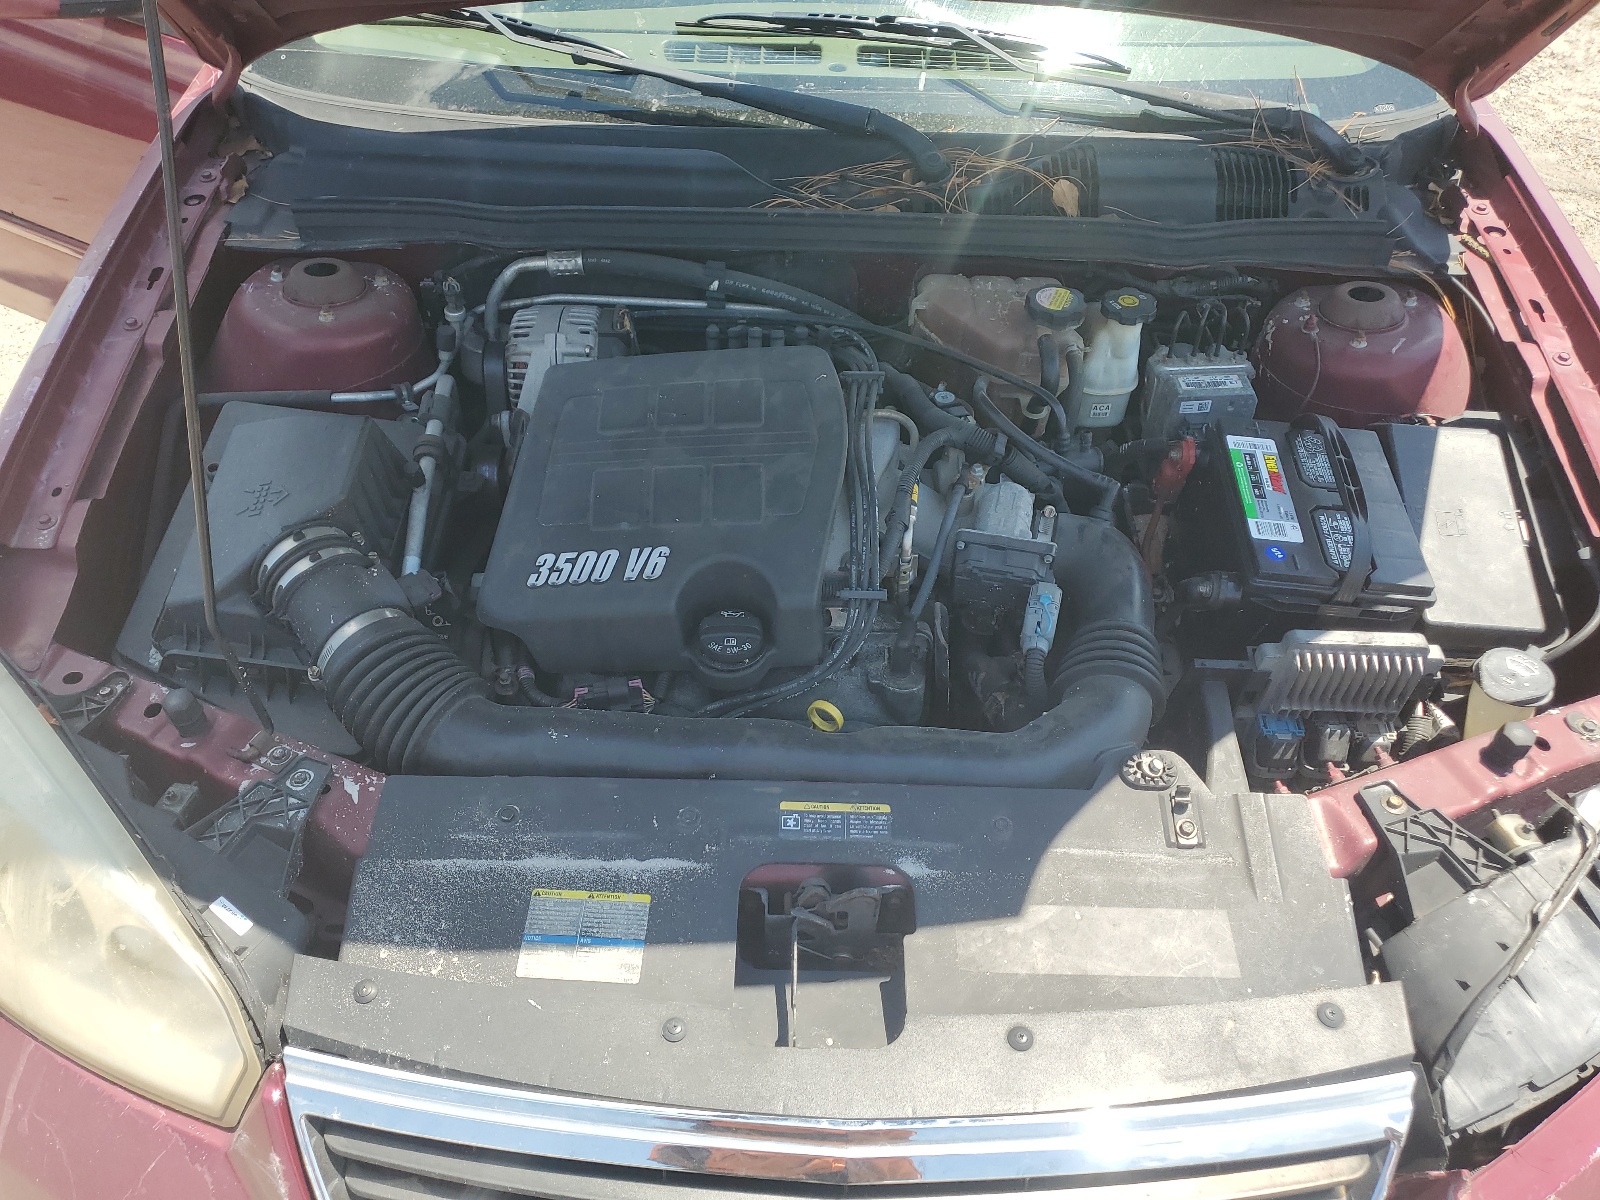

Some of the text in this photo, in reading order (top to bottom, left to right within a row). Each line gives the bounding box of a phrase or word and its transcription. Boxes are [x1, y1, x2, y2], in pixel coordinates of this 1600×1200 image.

[1092, 404, 1110, 412] ACA
[526, 546, 671, 588] 3500 V6
[708, 641, 752, 654] SAE 5W-30
